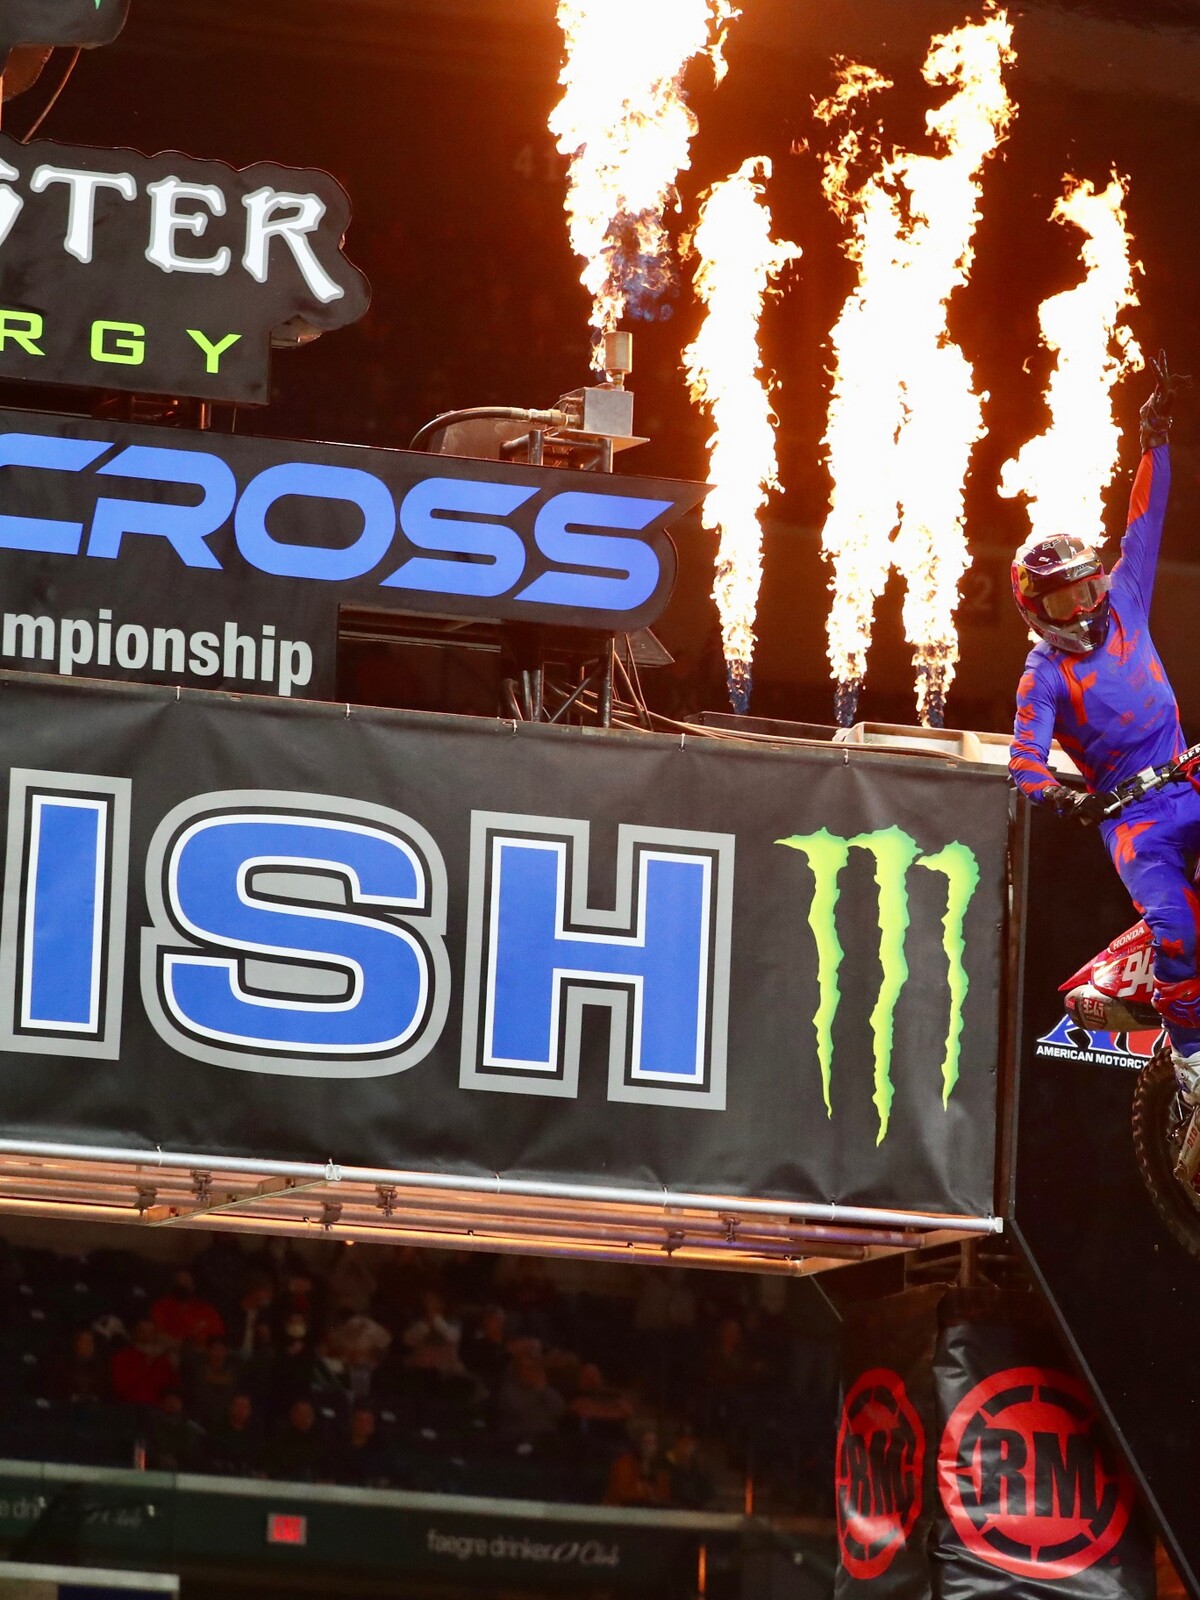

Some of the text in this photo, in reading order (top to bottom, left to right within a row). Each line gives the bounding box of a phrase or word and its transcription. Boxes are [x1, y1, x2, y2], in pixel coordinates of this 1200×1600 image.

[2, 609, 313, 697] mpionship
[0, 767, 736, 1111] ISH
[1113, 927, 1145, 949] HONDA
[1036, 1044, 1094, 1063] AMERICAN
